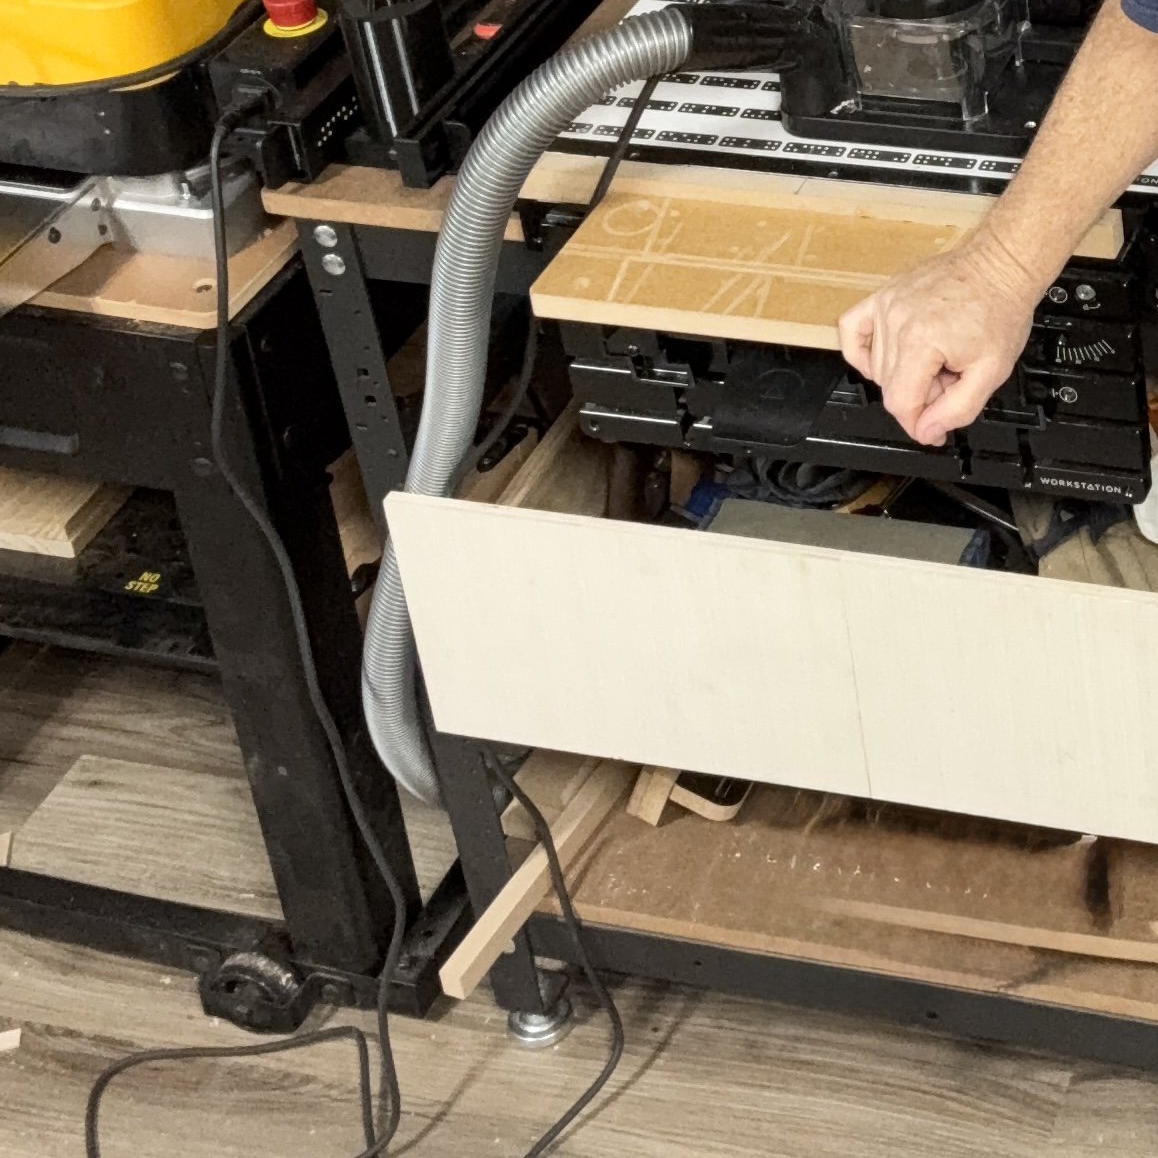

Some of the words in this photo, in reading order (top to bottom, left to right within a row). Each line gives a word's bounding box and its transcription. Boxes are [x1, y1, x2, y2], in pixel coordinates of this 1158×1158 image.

[1040, 477, 1121, 494] WORKSTATION
[138, 572, 161, 583] NO
[124, 580, 159, 594] STEP
